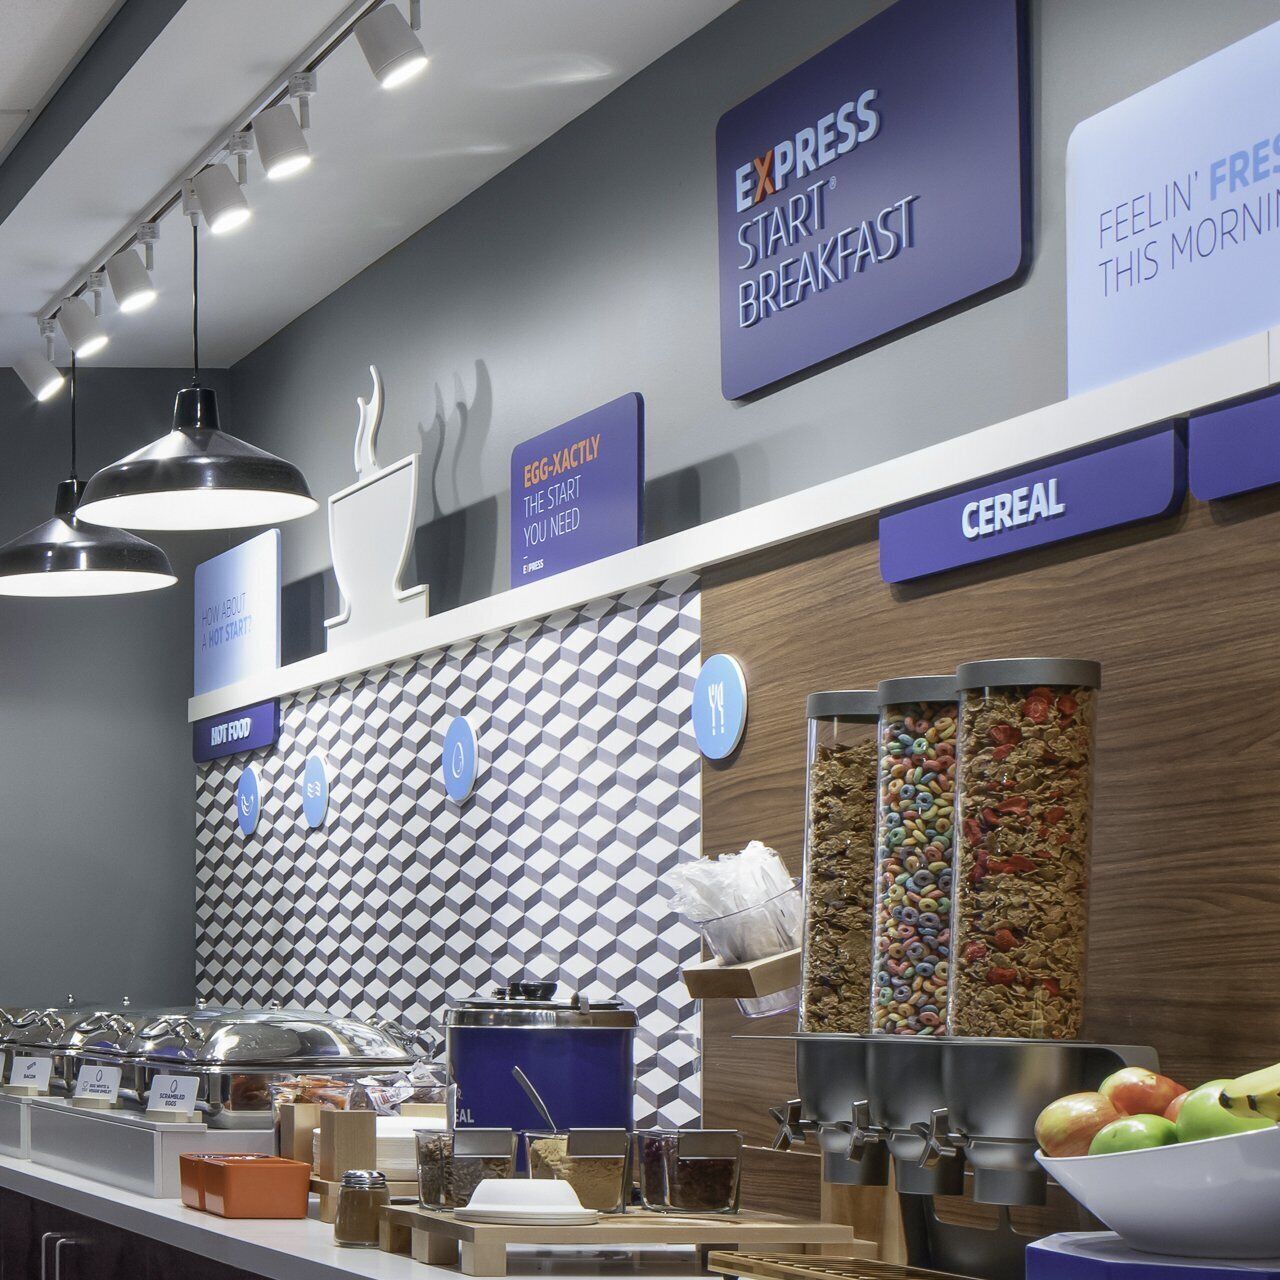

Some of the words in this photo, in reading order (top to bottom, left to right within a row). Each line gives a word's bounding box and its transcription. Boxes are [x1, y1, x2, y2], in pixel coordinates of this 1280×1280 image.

[736, 89, 878, 213] EXPRESS
[1100, 171, 1198, 248] FEELIN'
[739, 195, 920, 328] BREAKFAST
[1099, 240, 1159, 297] THIS
[1172, 188, 1280, 269] MORNI
[524, 433, 600, 488] EGG-XACTLY
[523, 490, 544, 518] THE
[547, 475, 581, 509] START
[962, 478, 1067, 539] CEREAL
[523, 519, 547, 547] YOU
[551, 507, 580, 538] NEED
[523, 559, 544, 574] EXPRESS
[202, 606, 220, 628] HOW
[222, 592, 247, 618] ABOUT
[202, 634, 207, 650] A
[208, 626, 224, 648] HOT
[226, 614, 252, 641] START?
[210, 723, 228, 746] HOT
[228, 717, 251, 742] FOOD
